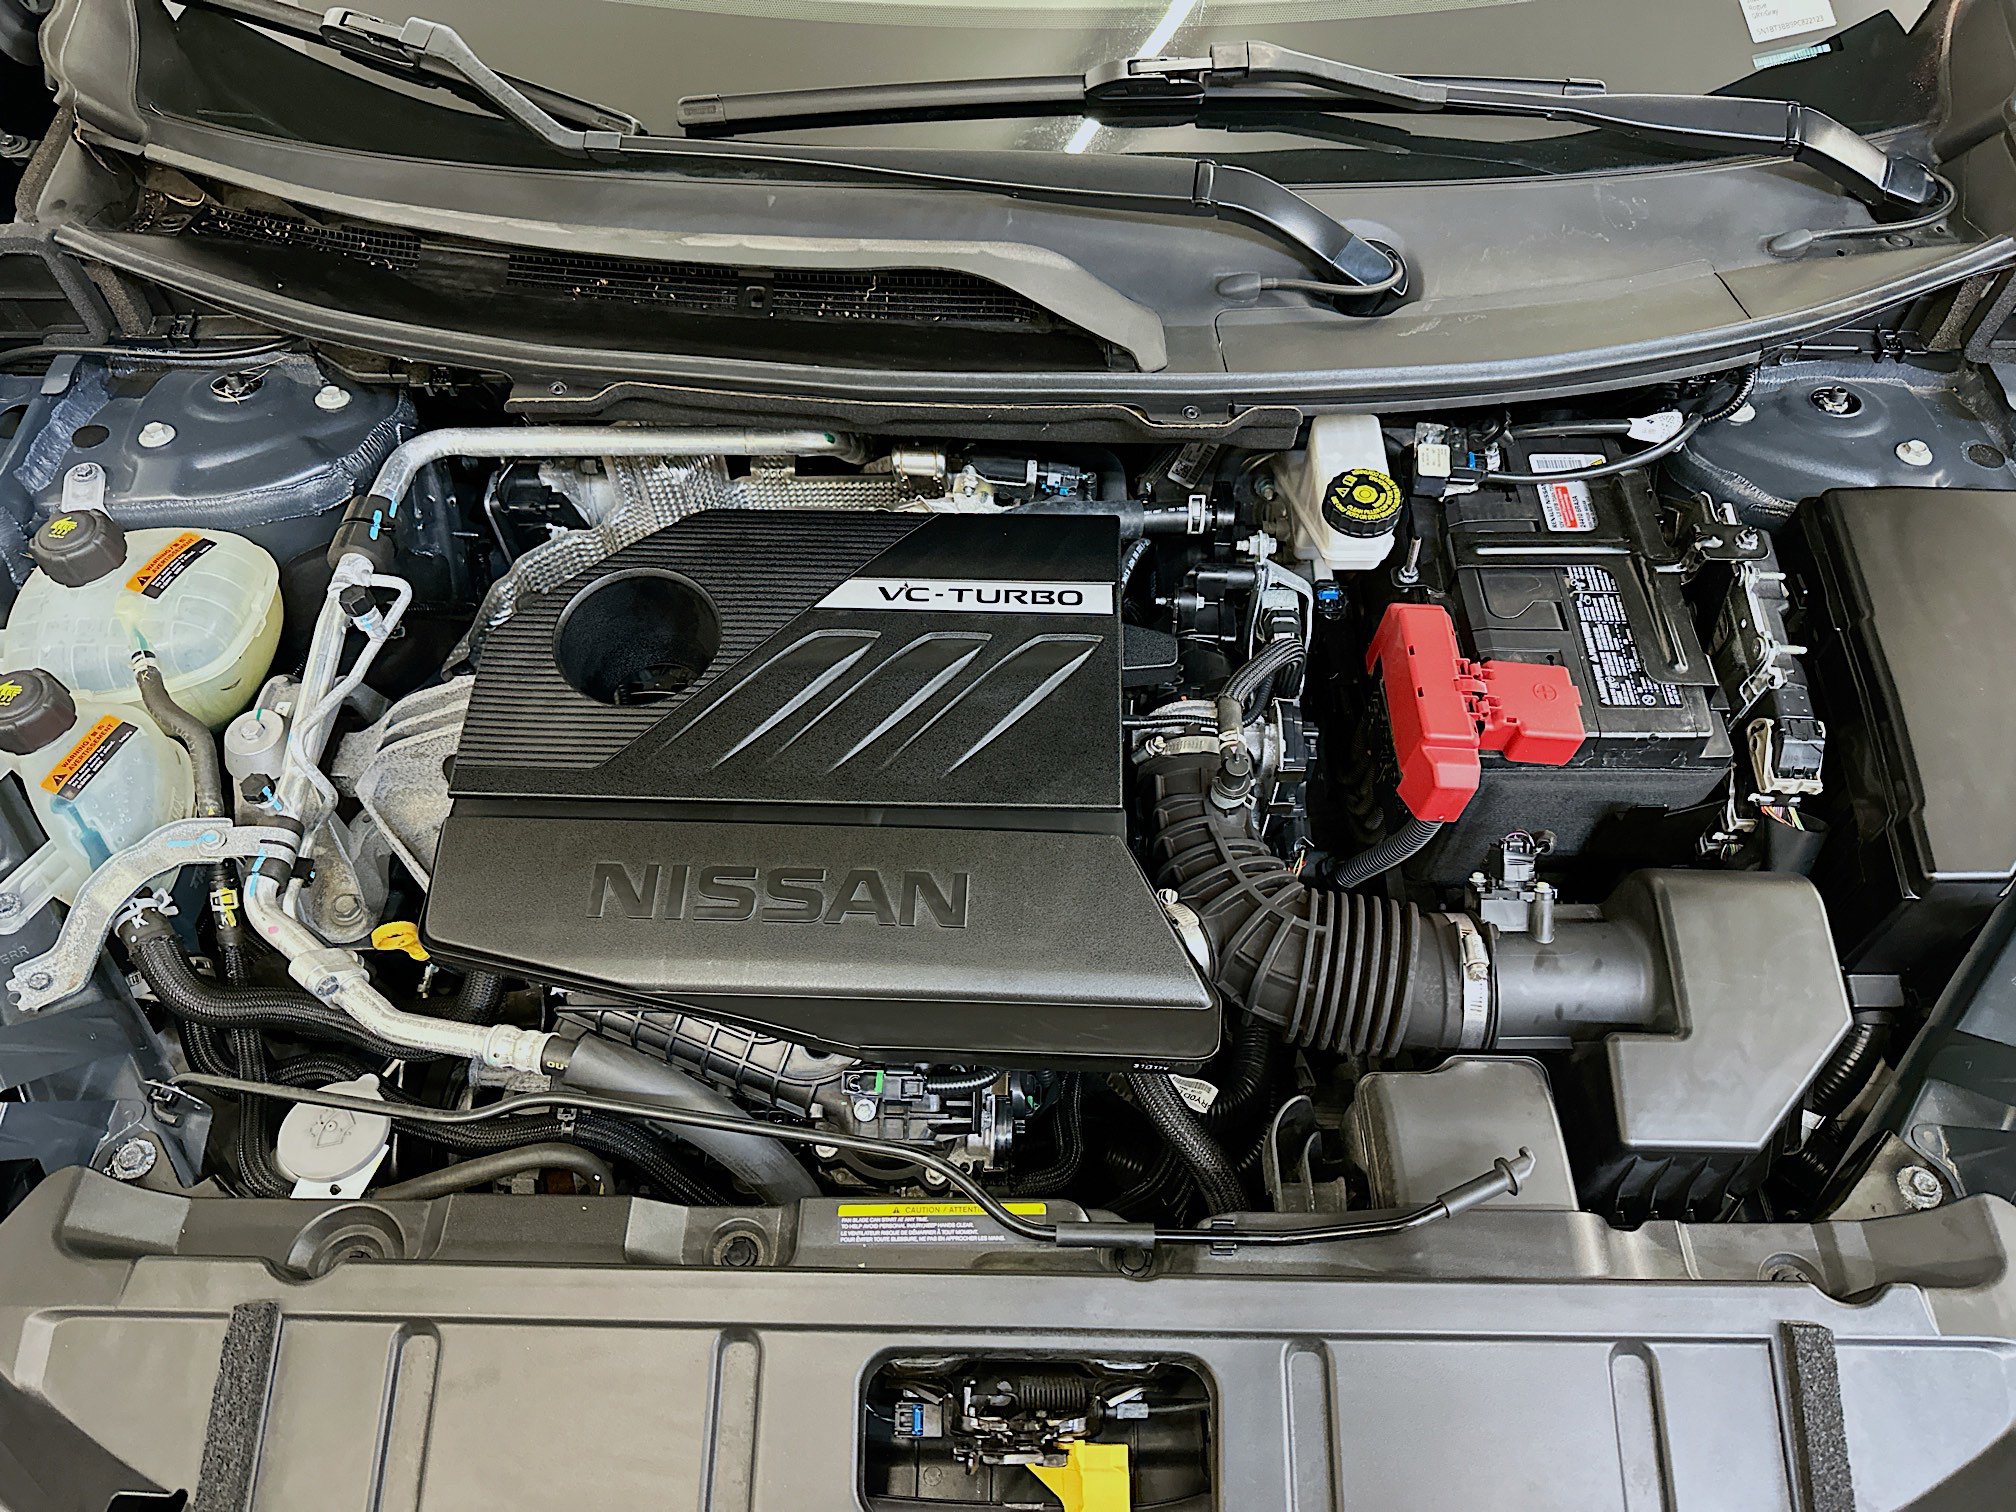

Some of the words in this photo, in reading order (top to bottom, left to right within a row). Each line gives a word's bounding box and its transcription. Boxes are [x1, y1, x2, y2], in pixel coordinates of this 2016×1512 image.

[146, 549, 170, 571] WARNING
[152, 538, 194, 573] AVERTISSEMENT
[878, 587, 1083, 606] VC-TURBO
[62, 741, 89, 768] WARNING
[69, 724, 113, 771] AVERTISSEMENT
[586, 863, 970, 928] NISSAN
